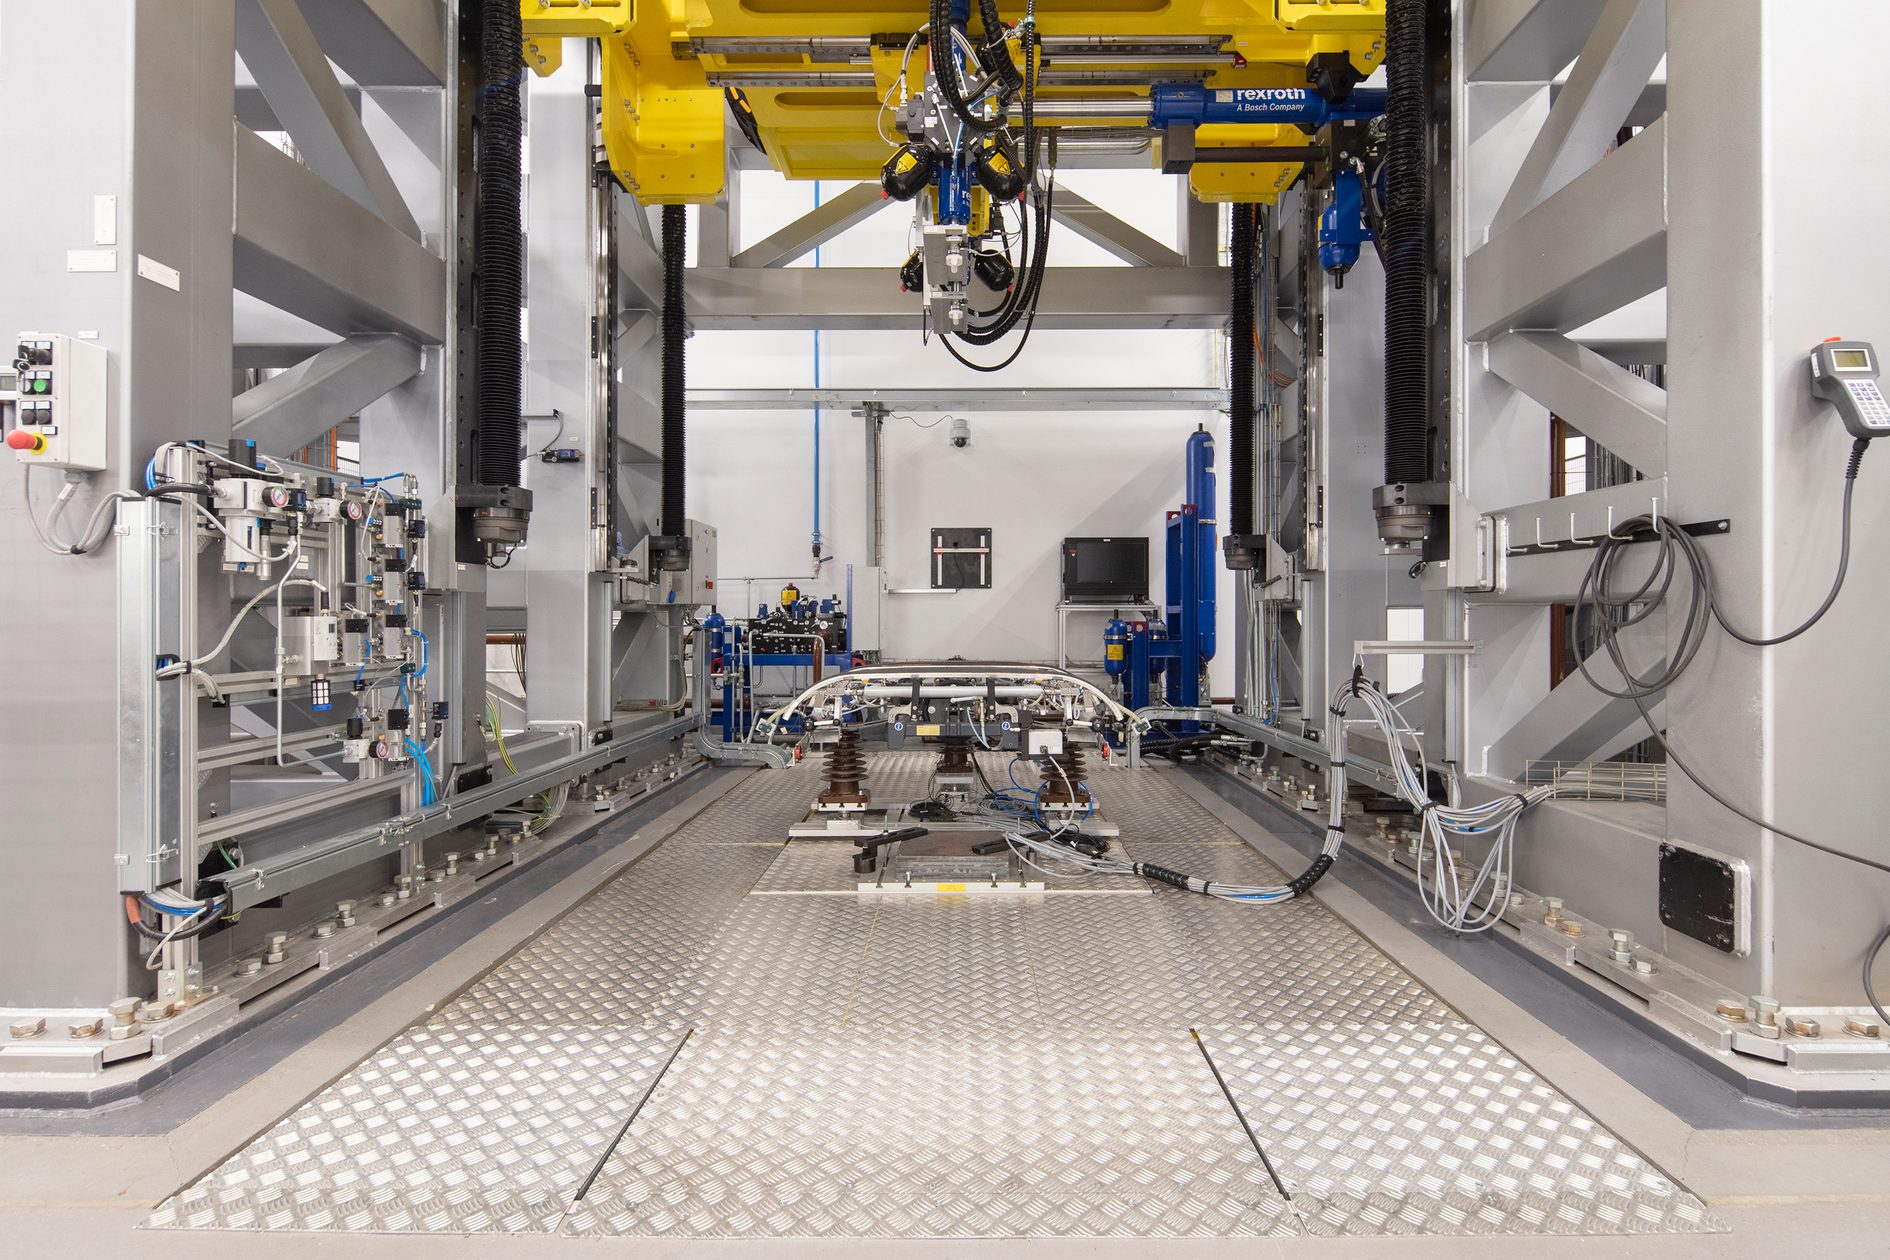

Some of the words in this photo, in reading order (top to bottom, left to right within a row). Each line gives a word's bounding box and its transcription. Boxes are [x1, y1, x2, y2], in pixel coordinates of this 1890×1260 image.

[1237, 88, 1306, 101] rexroth
[1236, 103, 1243, 112] A
[1244, 103, 1268, 112] Bosch
[1269, 103, 1305, 112] Company
